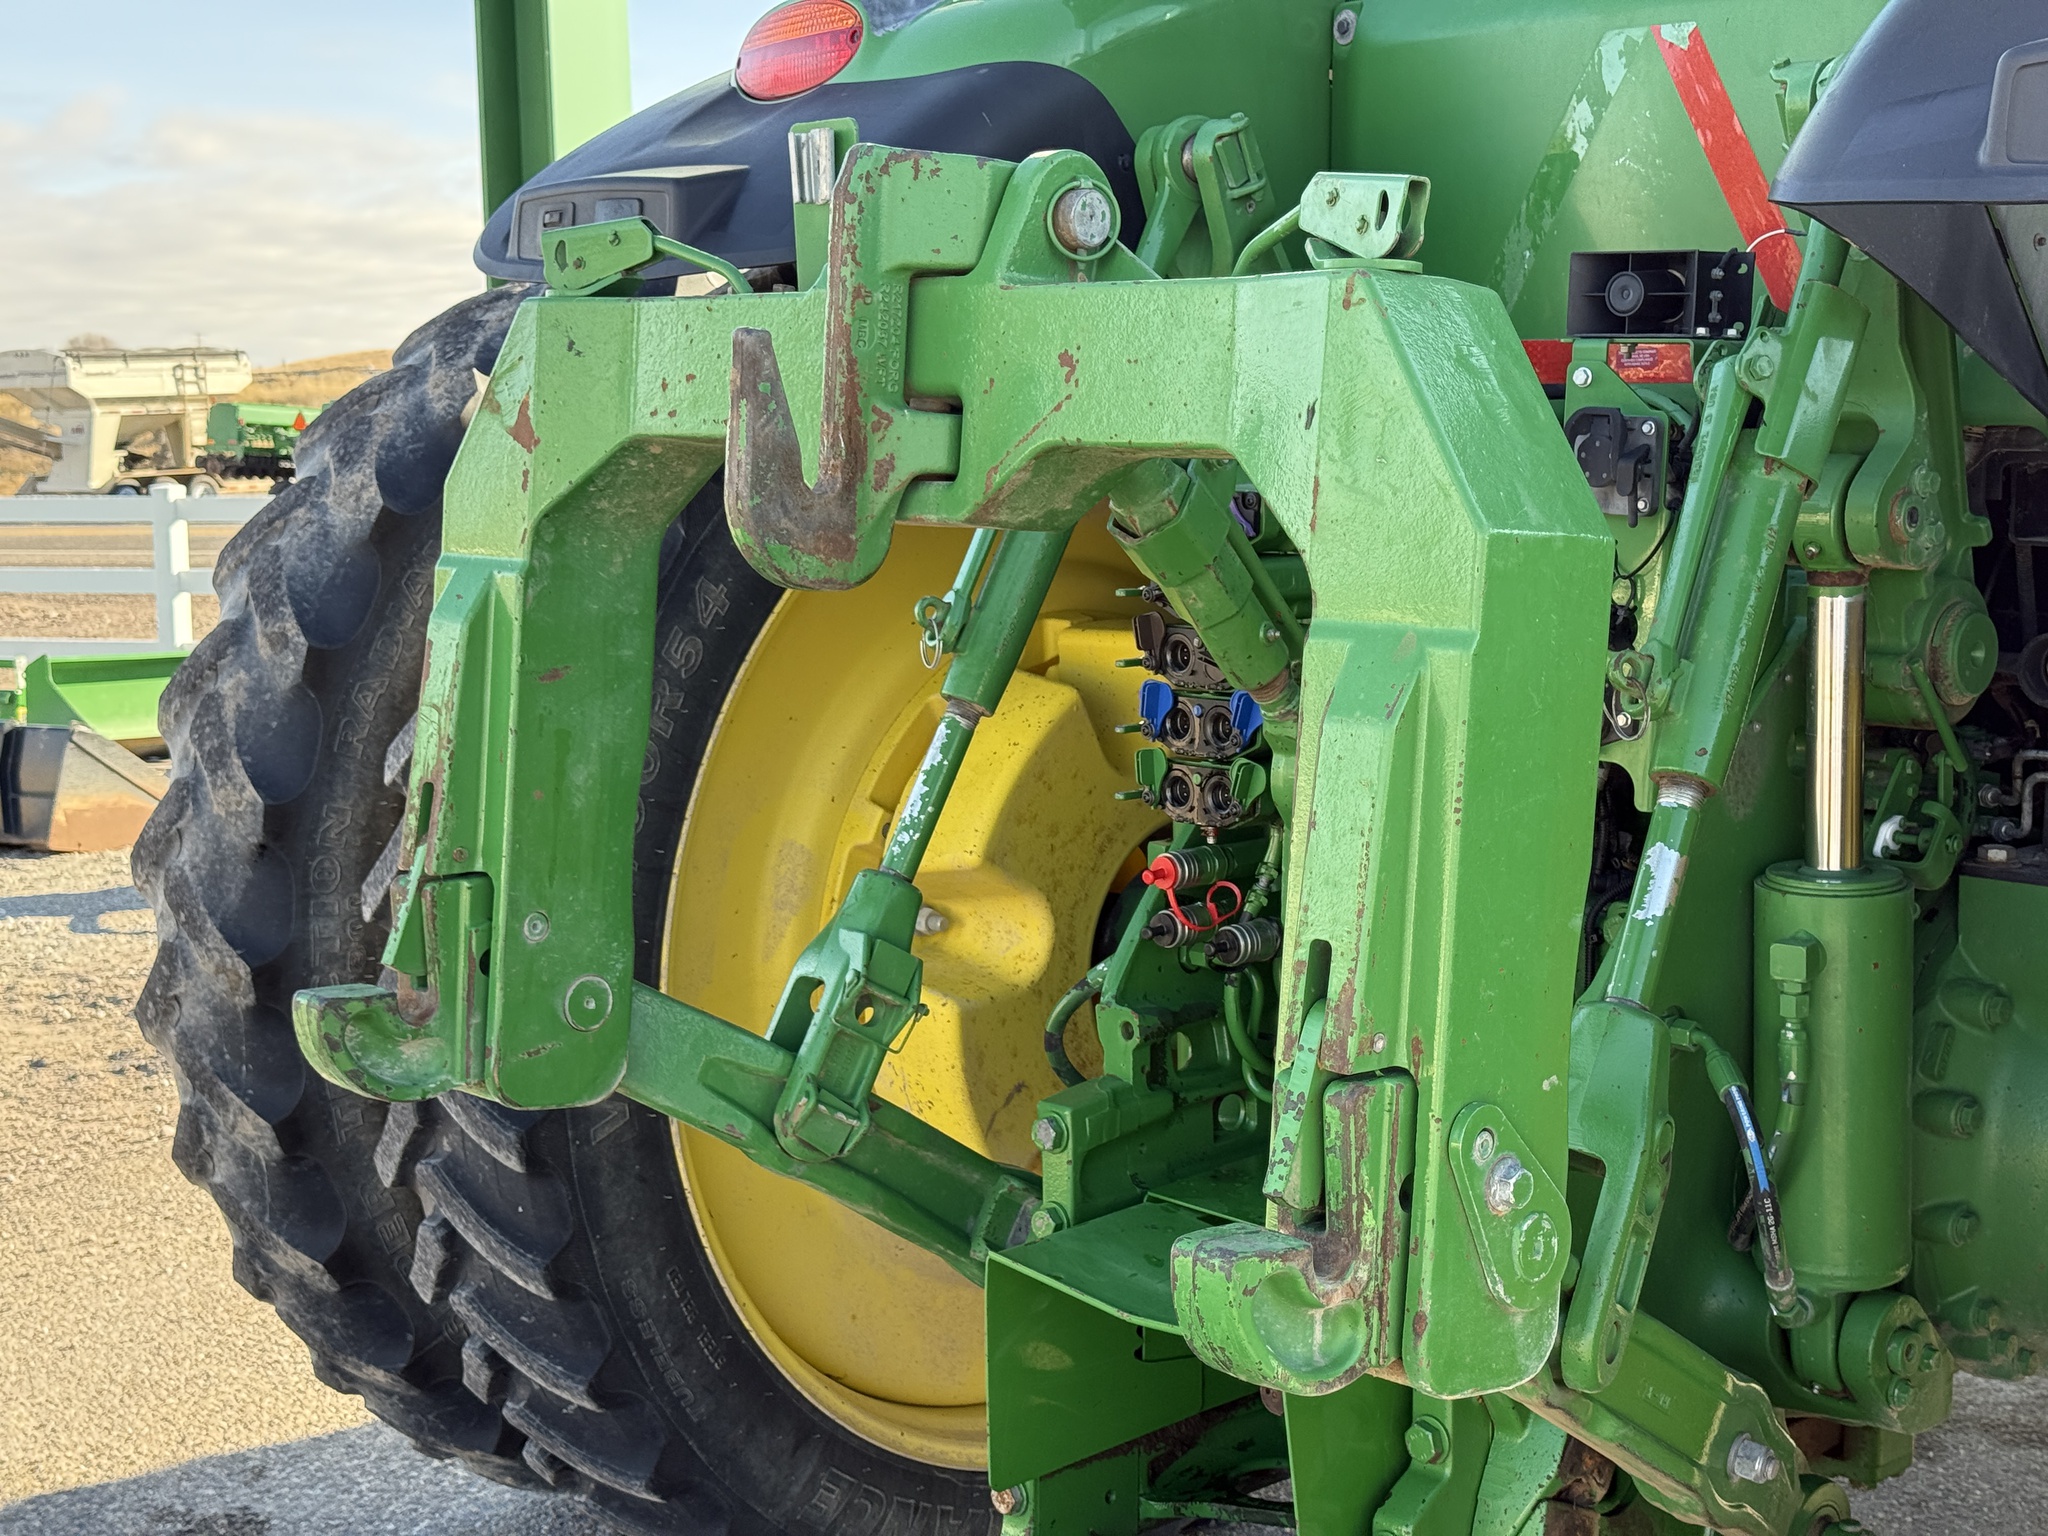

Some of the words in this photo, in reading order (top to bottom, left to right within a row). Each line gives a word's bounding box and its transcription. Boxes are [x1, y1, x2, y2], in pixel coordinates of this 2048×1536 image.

[665, 1265, 700, 1324] BELTED
[621, 1277, 706, 1423] TUBELESS
[696, 1324, 727, 1371] STEEL
